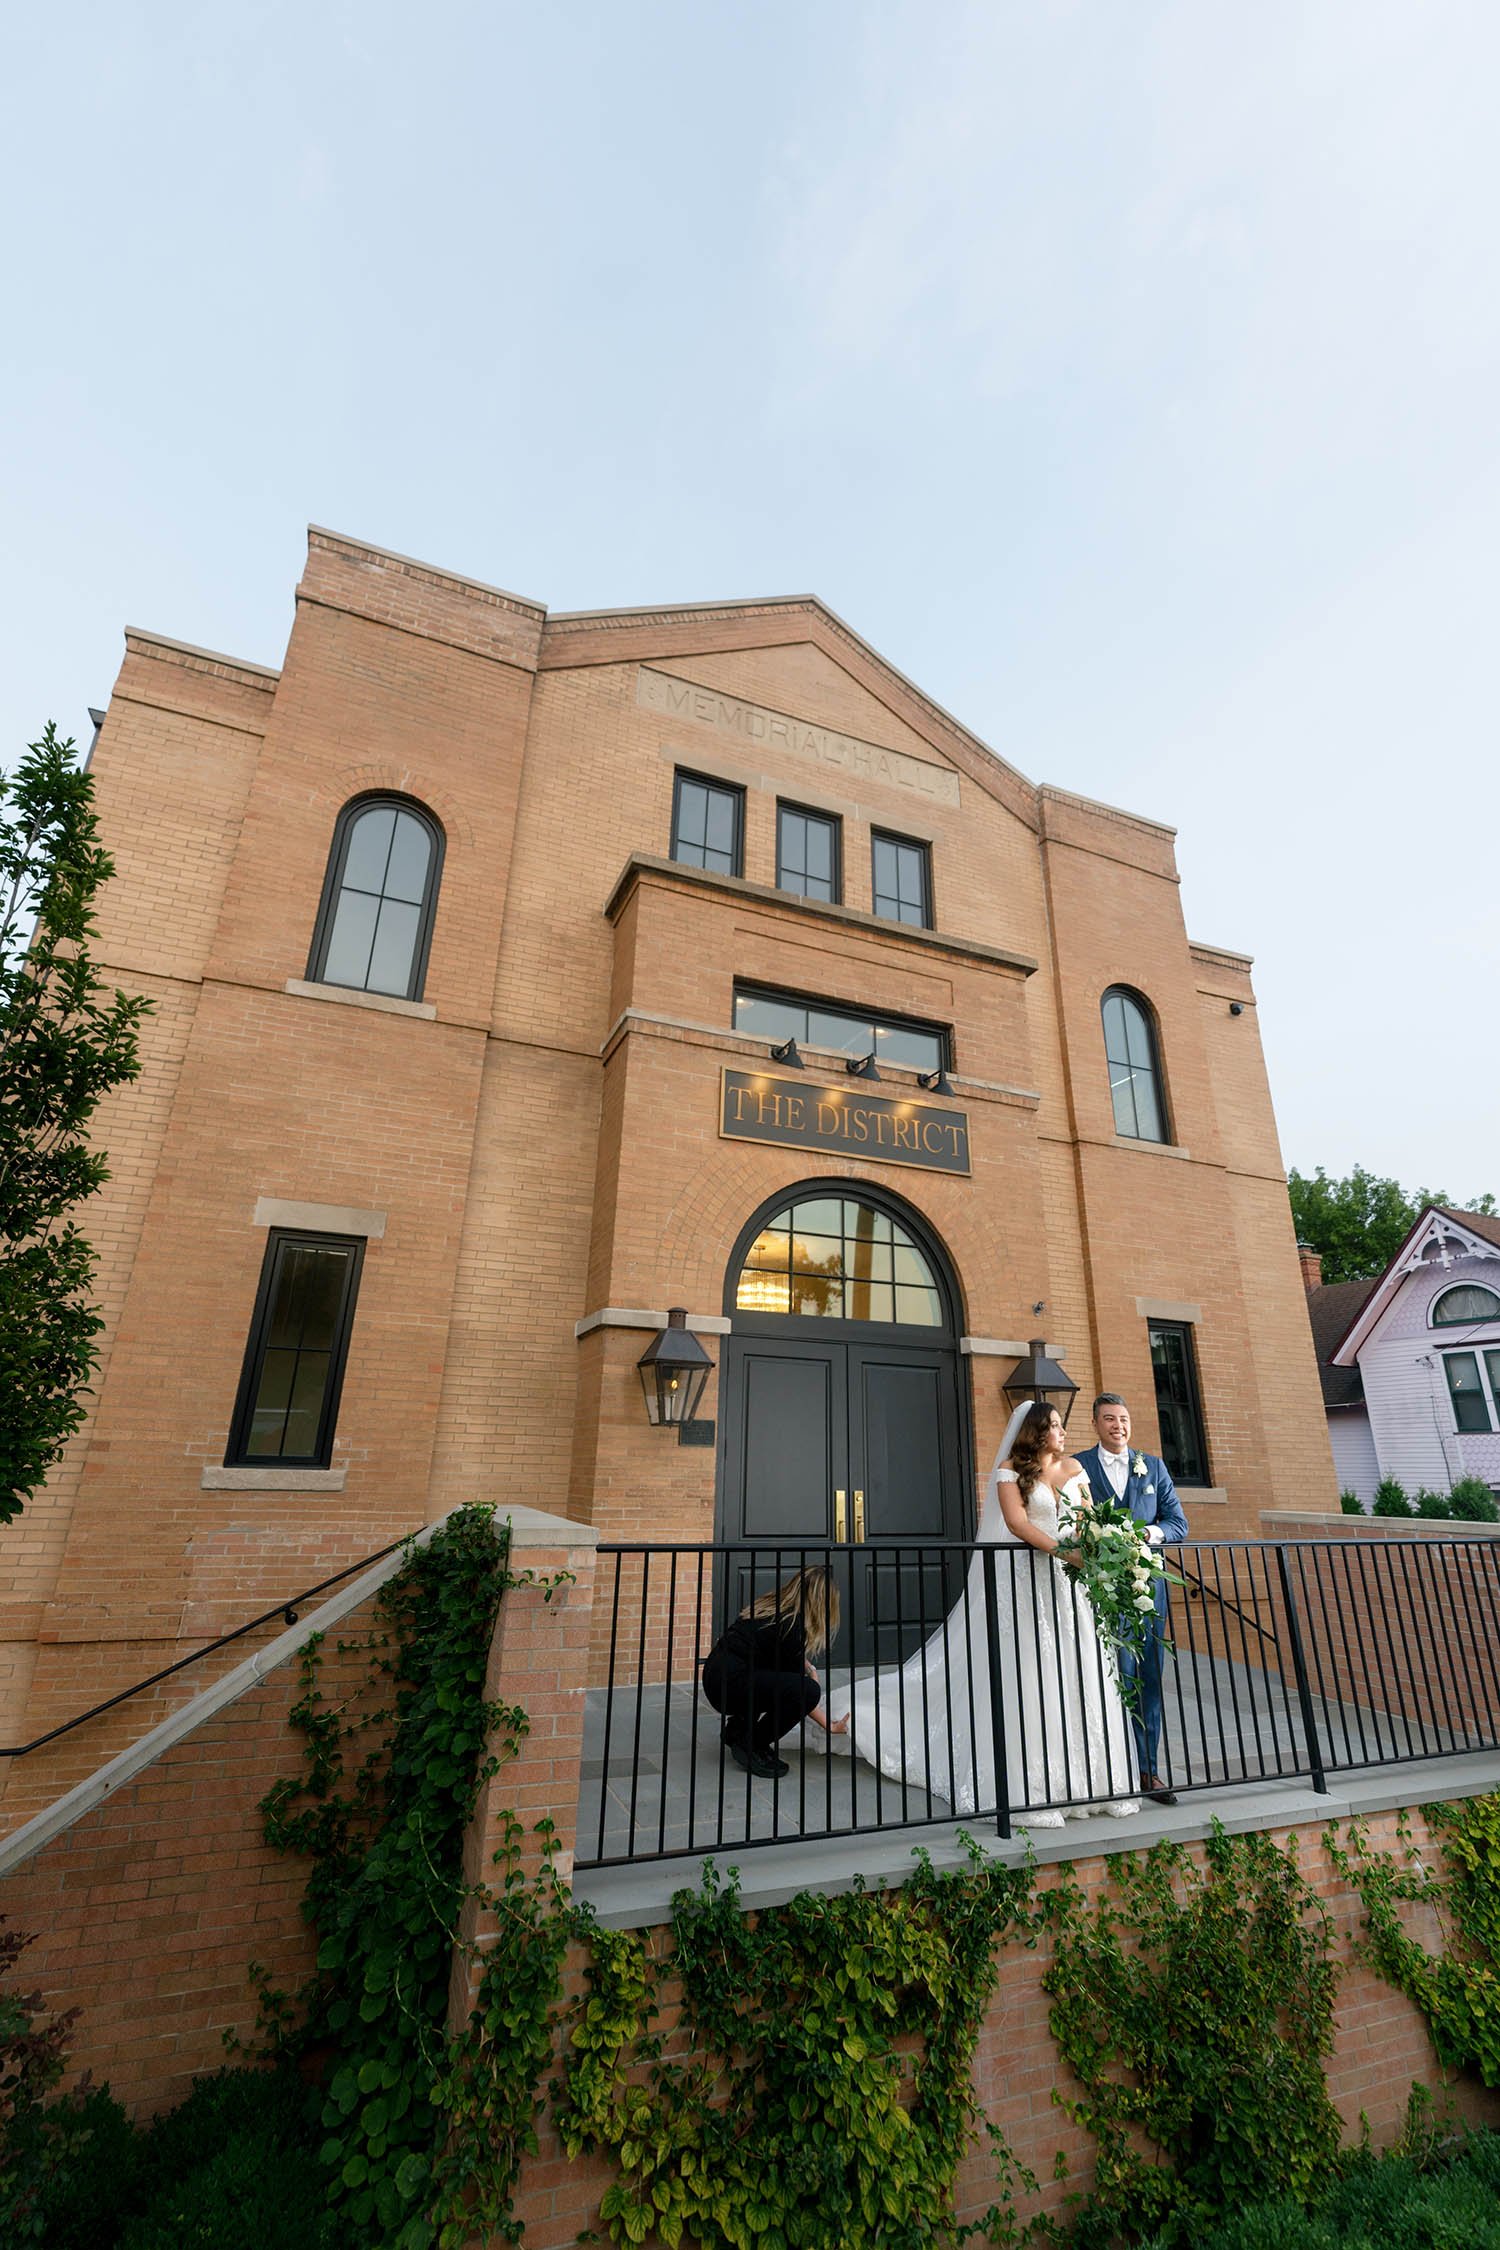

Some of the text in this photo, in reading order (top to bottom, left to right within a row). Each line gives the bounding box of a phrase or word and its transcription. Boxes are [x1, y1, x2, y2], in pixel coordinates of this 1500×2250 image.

[667, 684, 935, 794] MEMORIAL HALL
[728, 1087, 965, 1157] THE DISTRICT
